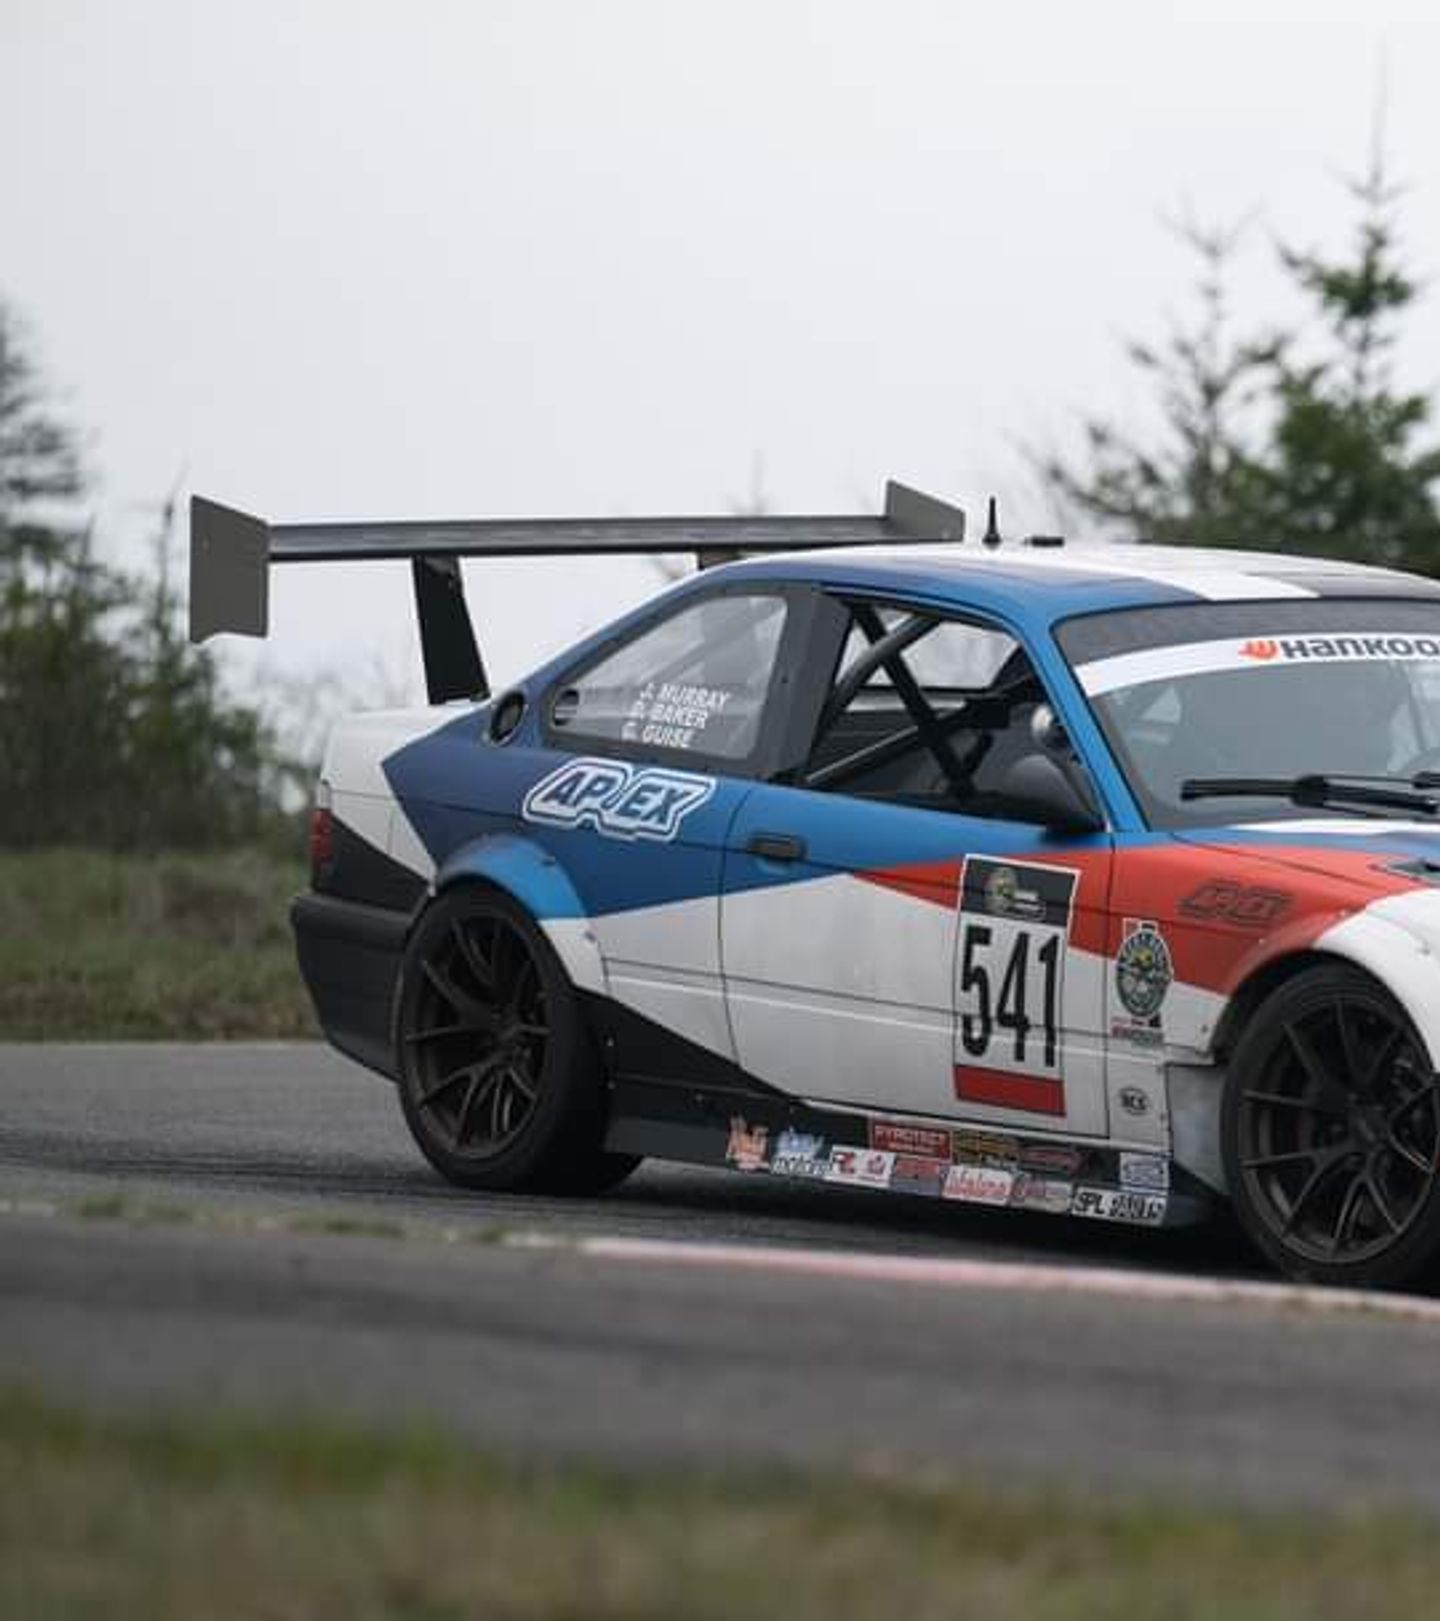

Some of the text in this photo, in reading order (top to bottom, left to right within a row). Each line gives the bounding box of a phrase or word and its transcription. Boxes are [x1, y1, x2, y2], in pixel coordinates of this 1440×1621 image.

[654, 683, 730, 710] MURRAY
[650, 702, 709, 729] BAKER
[642, 724, 697, 748] GUISE
[961, 923, 1060, 1068] 541
